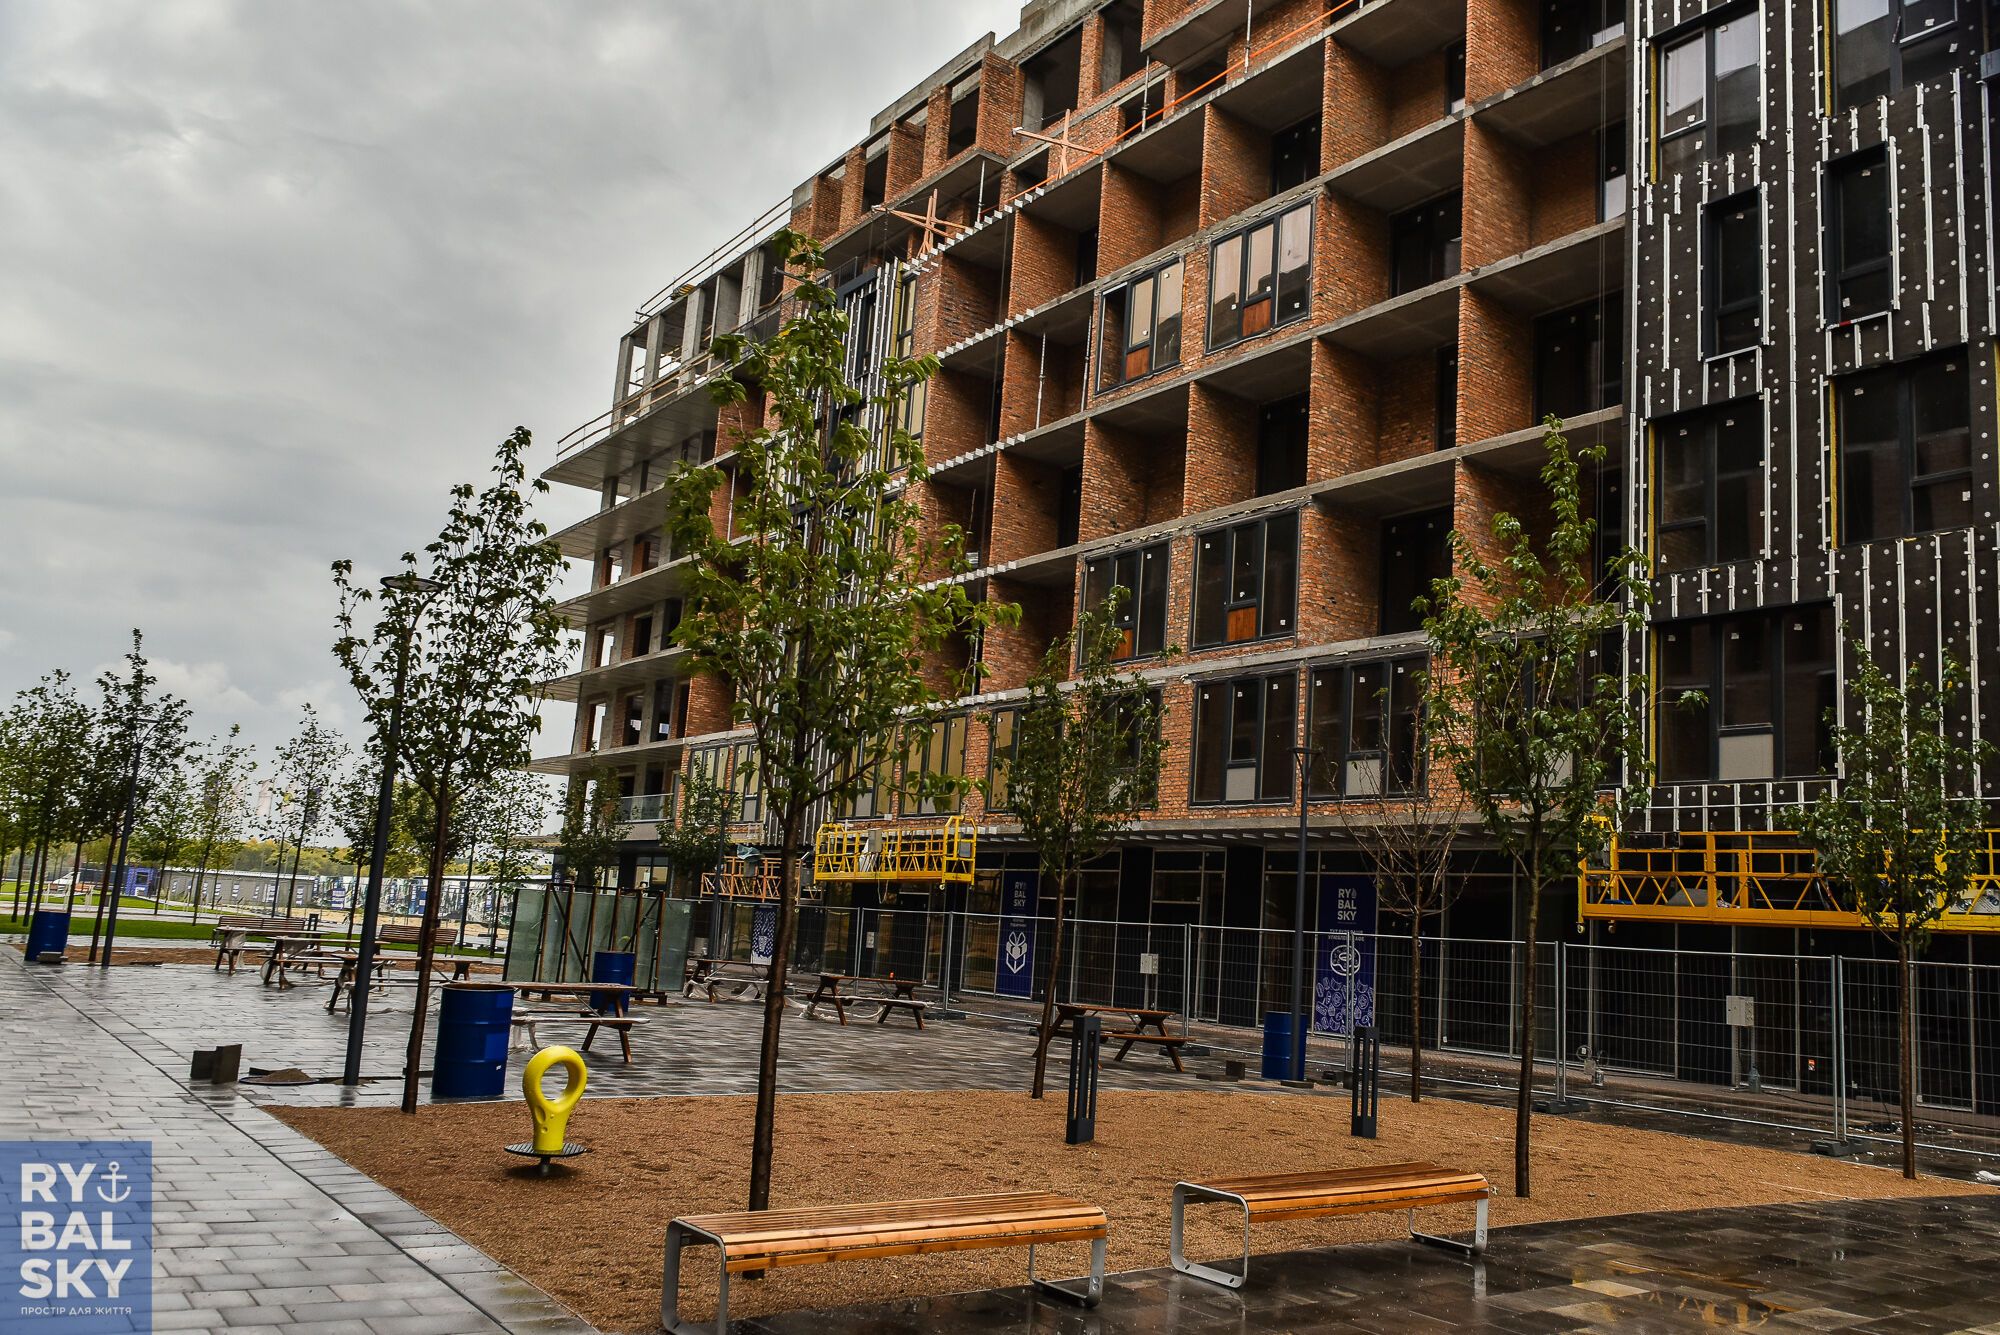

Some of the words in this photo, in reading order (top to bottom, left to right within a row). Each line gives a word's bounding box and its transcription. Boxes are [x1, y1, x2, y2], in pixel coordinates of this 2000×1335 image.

[1014, 890, 1026, 898] BAL
[1338, 888, 1351, 898] RY
[1013, 899, 1026, 907] SKY
[1338, 900, 1356, 909] BAL
[1337, 910, 1357, 920] SKY
